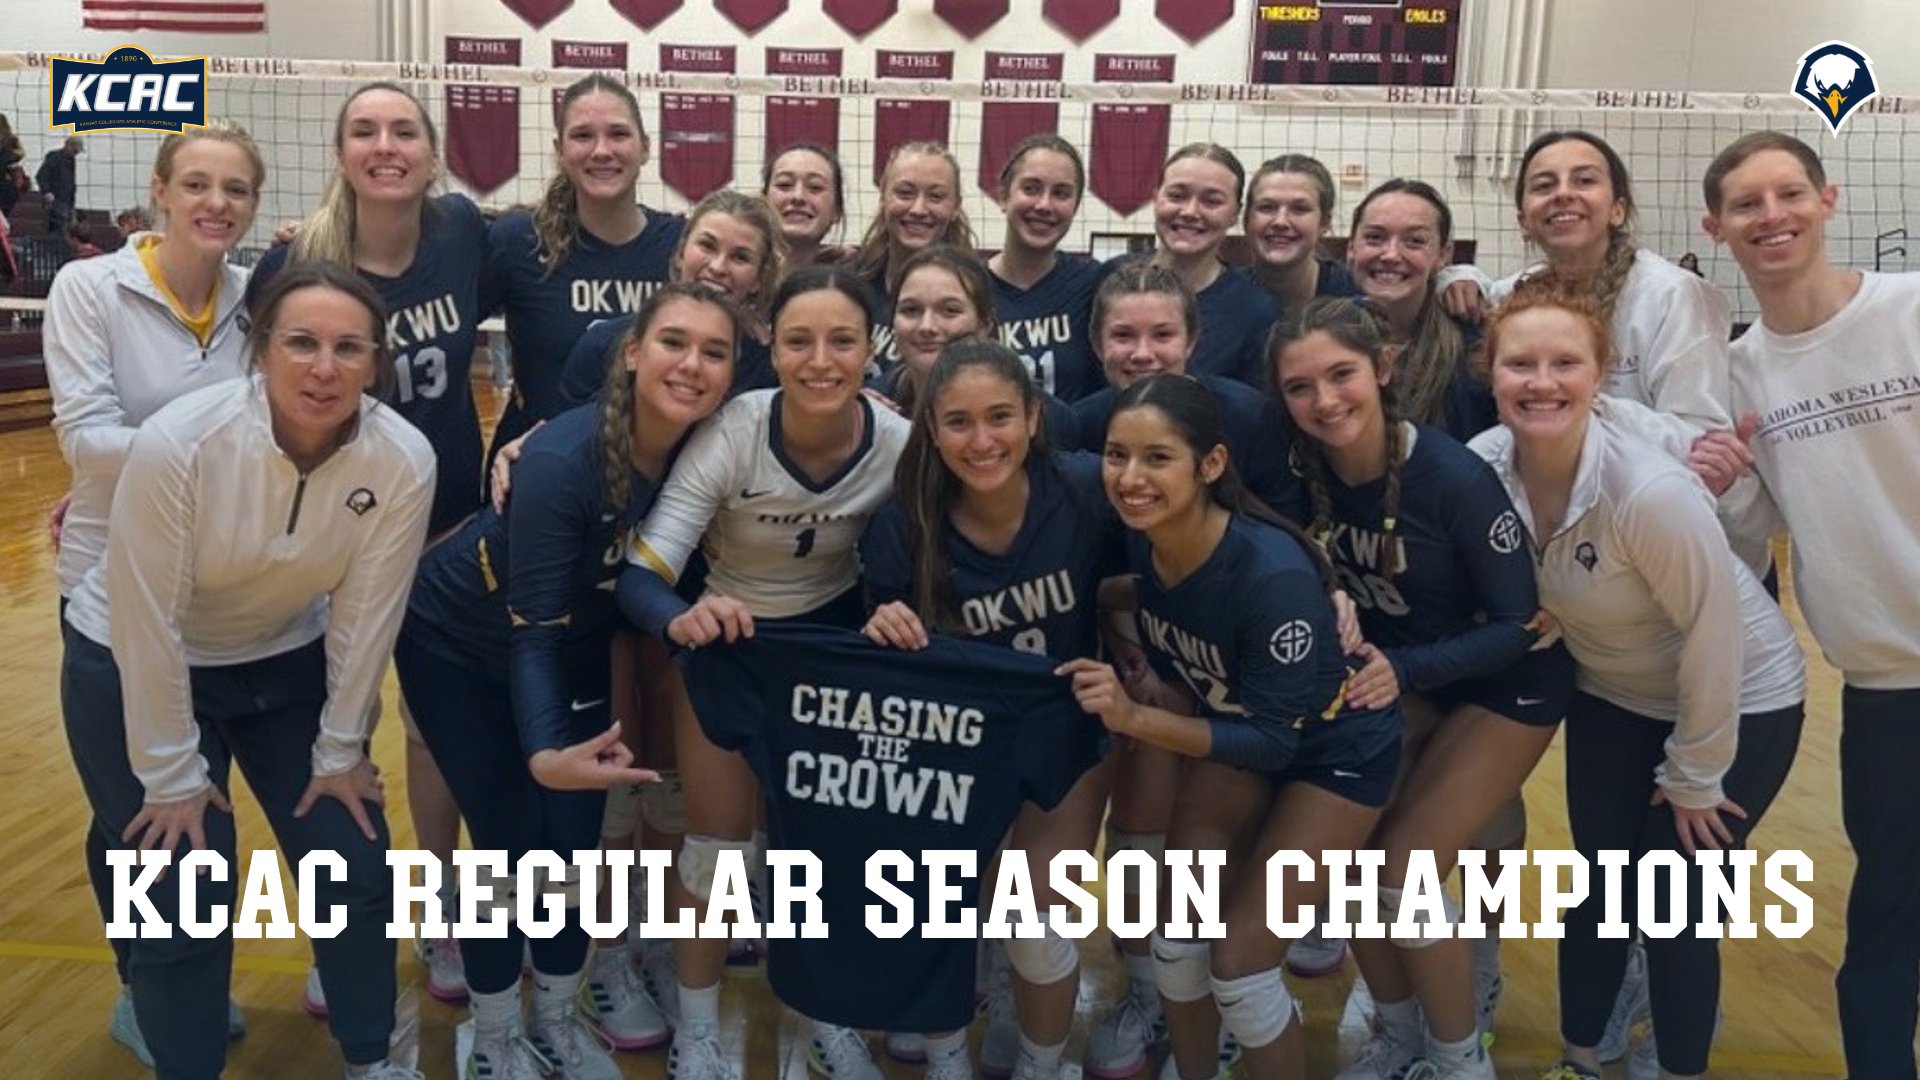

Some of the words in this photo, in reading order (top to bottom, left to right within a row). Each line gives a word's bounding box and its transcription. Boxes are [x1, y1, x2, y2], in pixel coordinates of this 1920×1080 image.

[1260, 6, 1320, 21] THRESHERS
[1405, 8, 1447, 23] EAGLES
[459, 41, 508, 53] BETHEL
[565, 46, 616, 57] BETHEL
[673, 49, 722, 61] BETHEL
[779, 52, 829, 64] BETHEL
[889, 55, 940, 67] BETHEL
[998, 58, 1050, 70] BETHEL
[1262, 51, 1288, 61] FOULS
[1328, 53, 1360, 63] PLAYER
[1362, 53, 1382, 63] FOUL
[1421, 54, 1448, 64] FOULS
[211, 60, 299, 76] BETHEL
[400, 64, 488, 80] BETHEL
[1108, 60, 1160, 71] BETHEL
[784, 77, 876, 94] BETHEL
[981, 80, 1073, 99] BETHEL
[1181, 84, 1276, 101] BETHEL
[1387, 87, 1482, 104] BETHEL
[1594, 90, 1696, 109] BETHEL
[385, 293, 460, 350] KWU
[395, 346, 448, 403] 13
[793, 528, 816, 559] 1
[962, 569, 1076, 636] OKWU
[1140, 607, 1228, 679] OKWU
[1172, 660, 1254, 717] 12
[791, 684, 985, 747] CHASING
[857, 733, 910, 763] THE
[786, 750, 974, 825] CROWN
